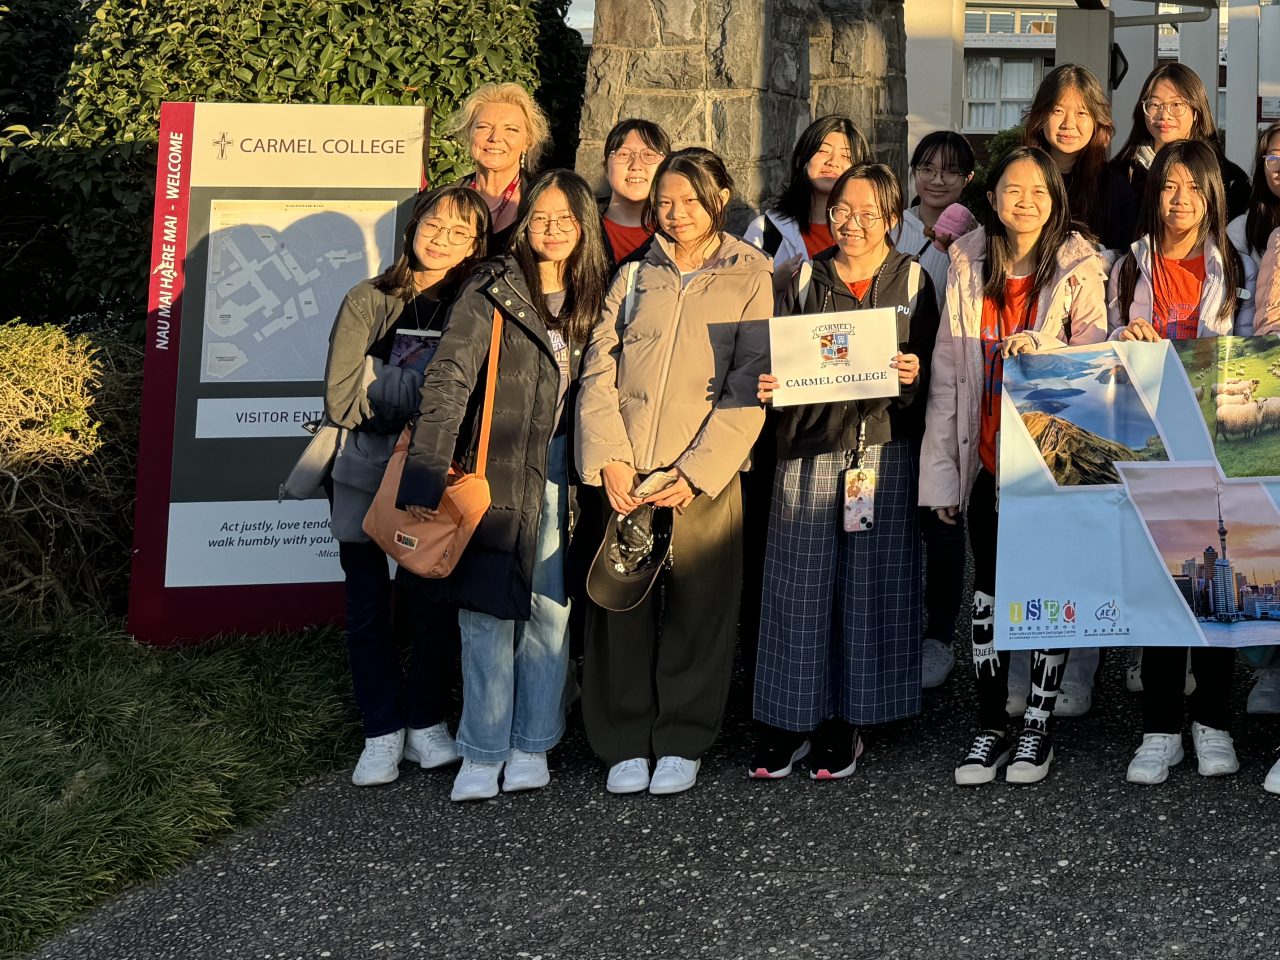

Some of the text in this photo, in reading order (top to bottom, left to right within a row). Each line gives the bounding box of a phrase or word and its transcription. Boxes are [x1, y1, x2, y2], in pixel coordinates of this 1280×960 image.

[240, 138, 405, 154] CARMEL COLLEGE
[166, 131, 183, 199] WELCOME
[164, 215, 178, 243] MAI
[160, 244, 176, 289] HAERE
[158, 291, 173, 318] MAI
[156, 320, 170, 350] NAU
[818, 323, 849, 333] CARMEL
[786, 371, 887, 388] CARMEL COLLEGE
[236, 411, 325, 423] VISITOR ENT
[220, 517, 331, 533] Act justly, love tende
[208, 537, 234, 547] walk
[237, 535, 280, 548] humbly
[283, 535, 307, 545] with
[1009, 598, 1077, 624] ISEC
[1100, 608, 1117, 617] AEA
